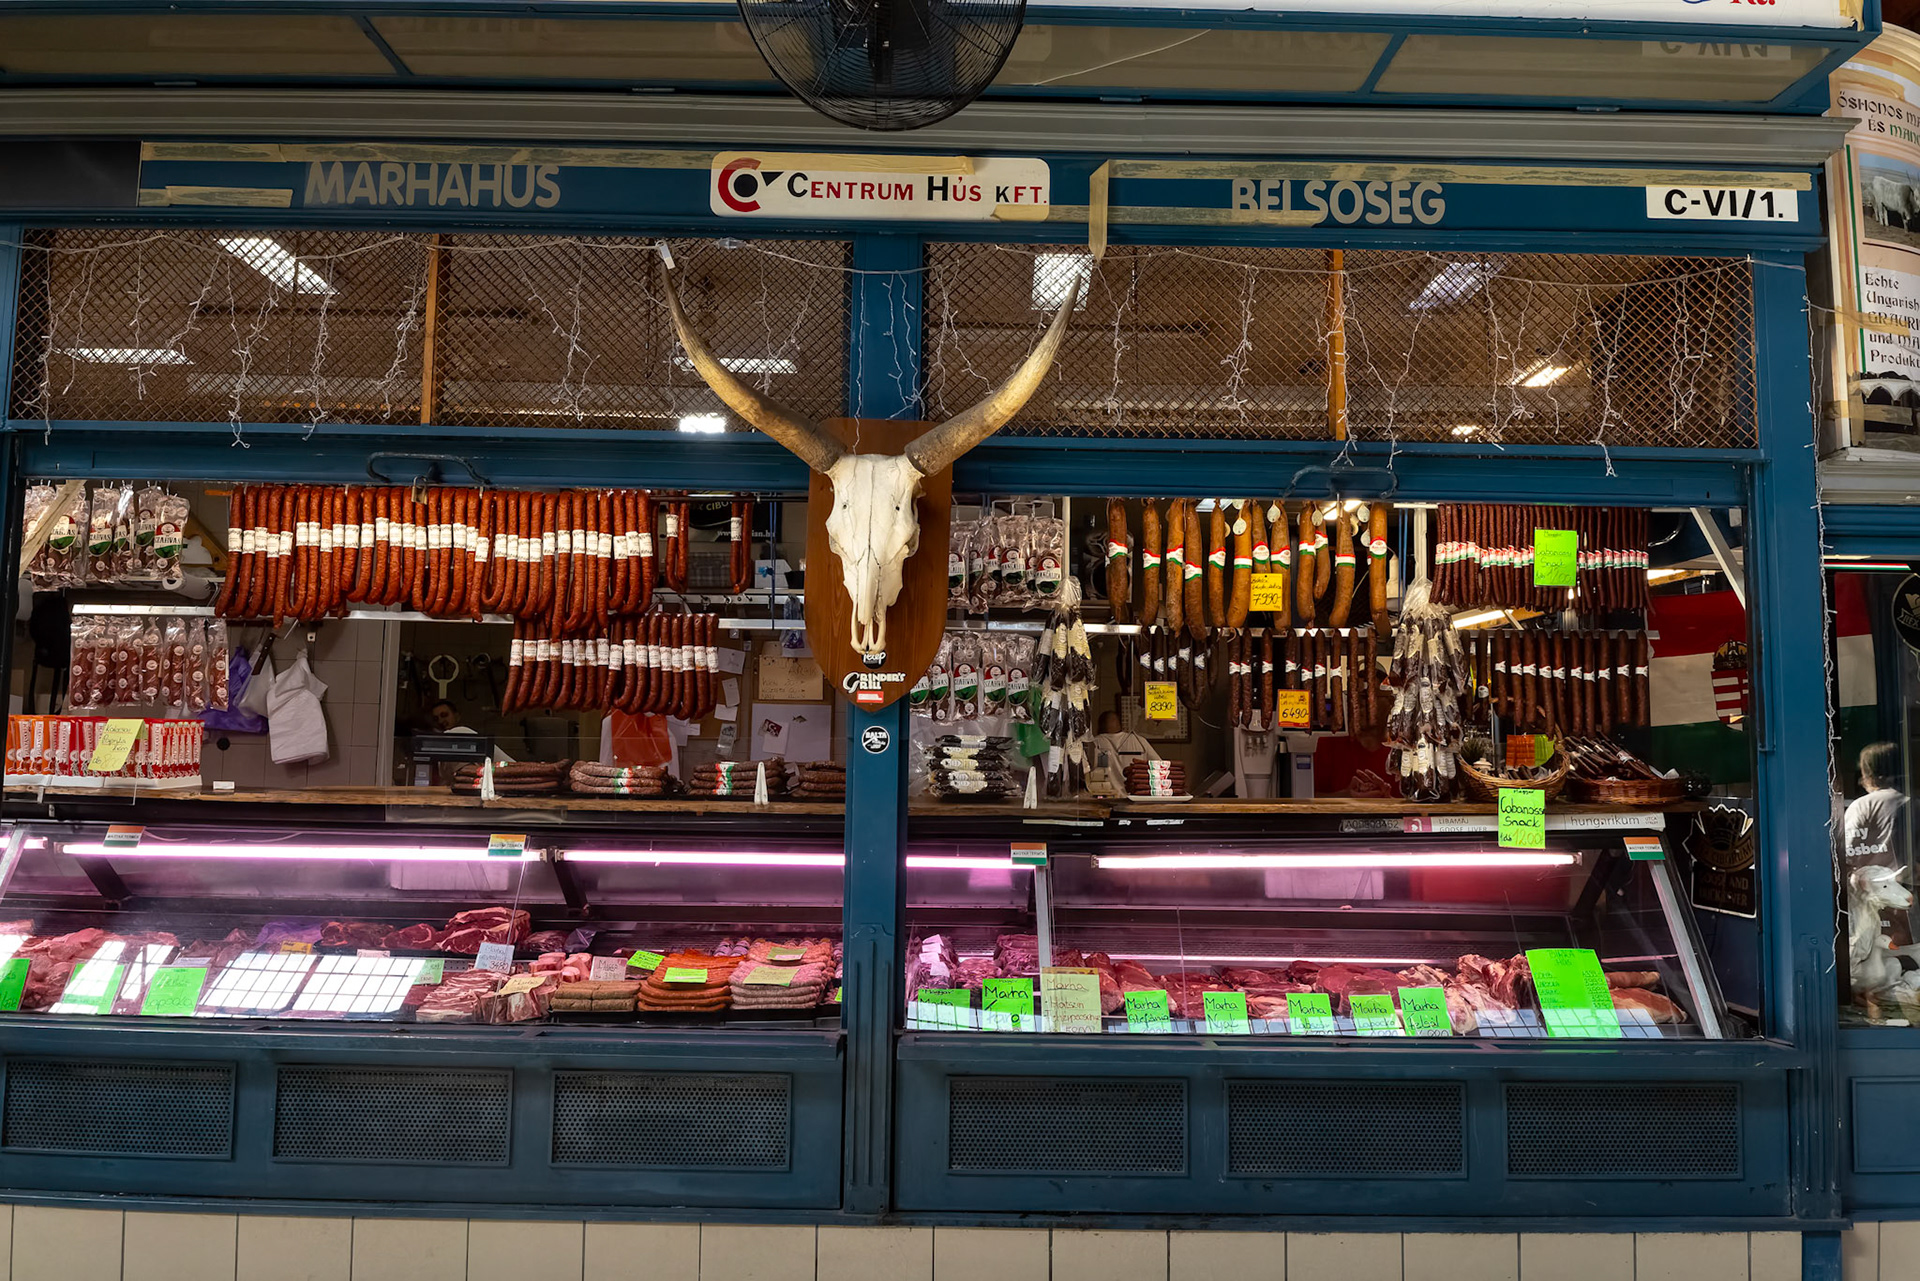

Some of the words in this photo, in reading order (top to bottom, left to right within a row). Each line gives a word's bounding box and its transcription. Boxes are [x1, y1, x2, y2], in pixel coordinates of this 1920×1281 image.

[788, 172, 913, 200] CENTRUM
[995, 185, 1047, 204] KFT.
[1665, 189, 1784, 219] C-VI/1.
[1865, 272, 1899, 290] Echte
[1869, 333, 1893, 345] und
[1571, 815, 1640, 828] hungarikum
[984, 986, 1029, 999] Marha
[1126, 998, 1161, 1010] Marha
[1205, 998, 1238, 1009] Marha
[1289, 999, 1327, 1015] Marha
[1352, 1002, 1388, 1014] Marha
[1402, 997, 1440, 1011] Marha
